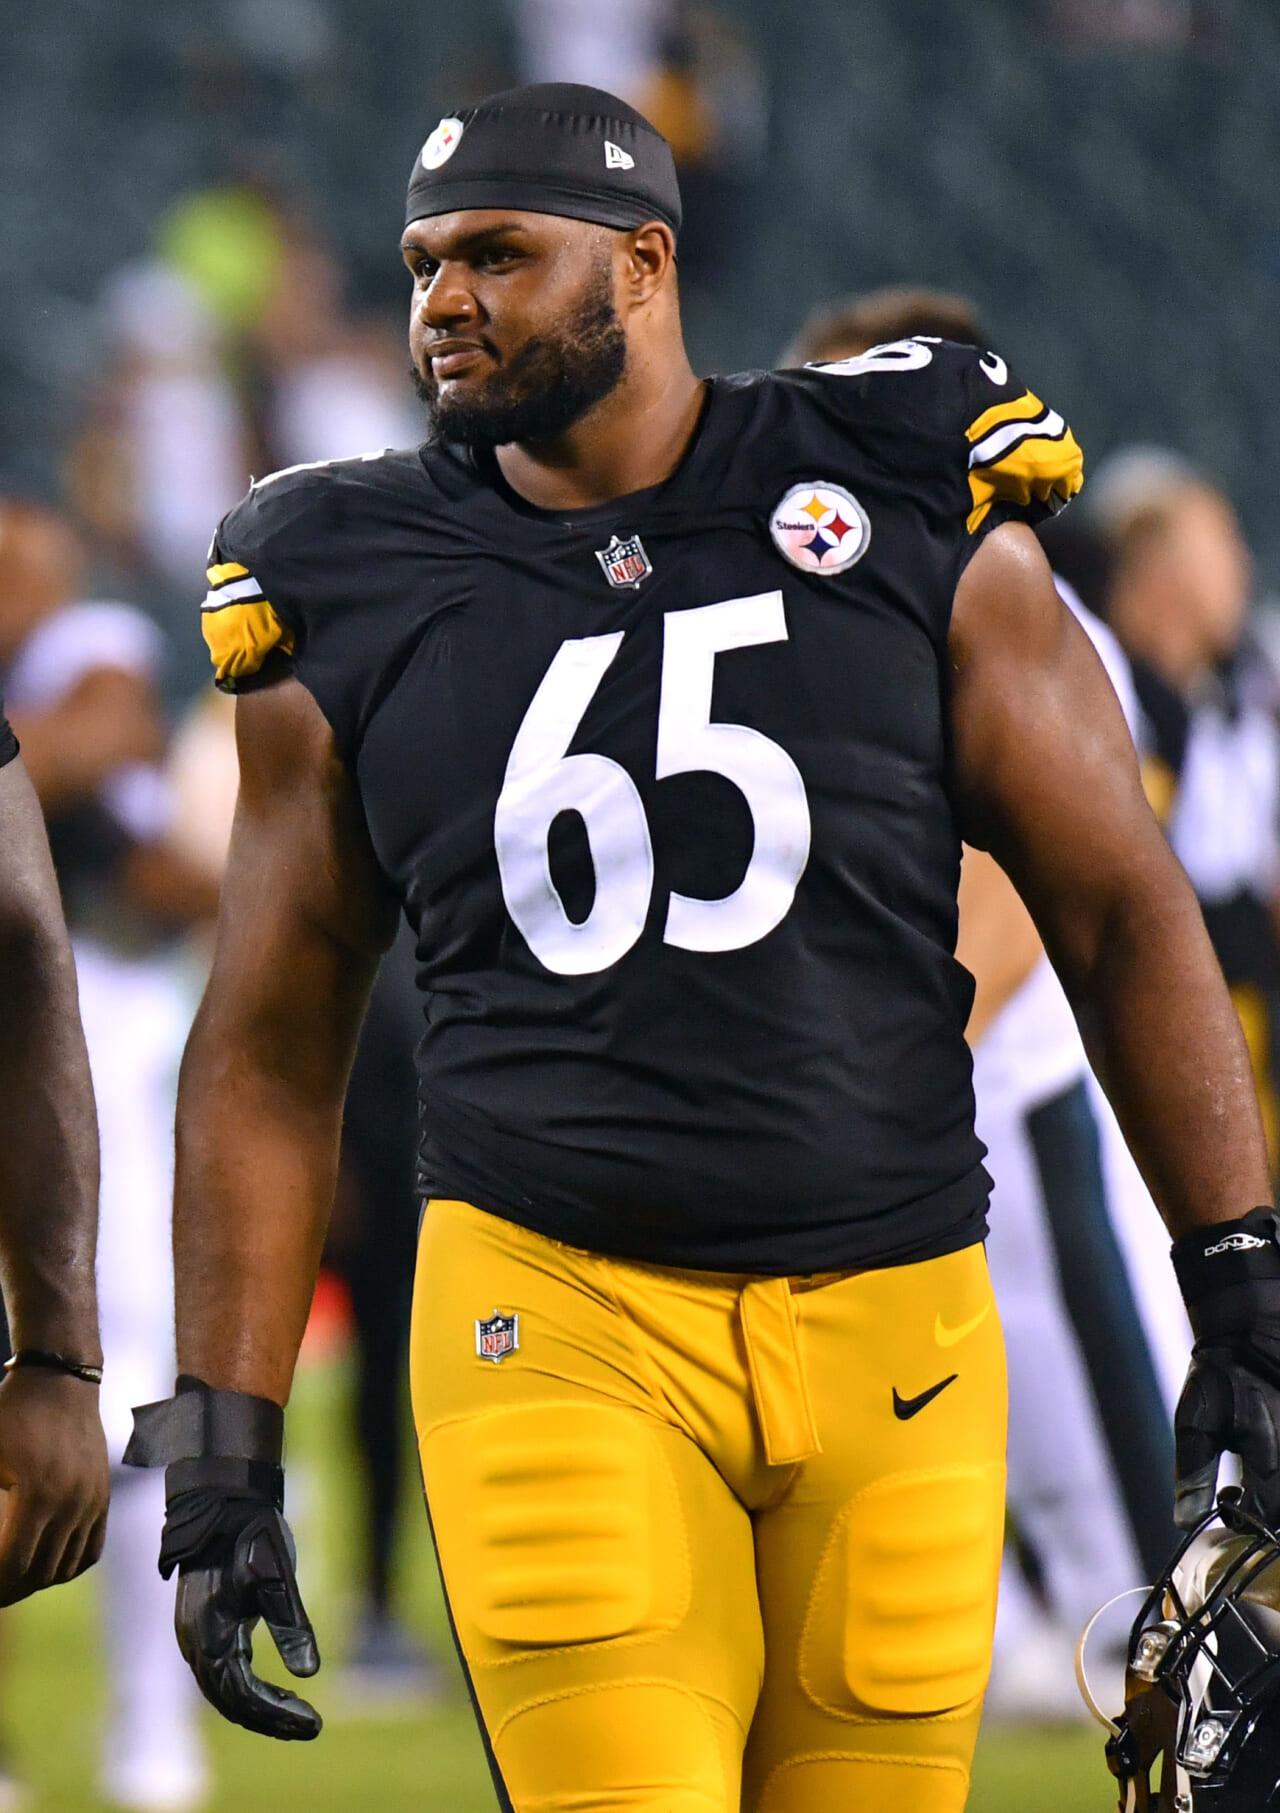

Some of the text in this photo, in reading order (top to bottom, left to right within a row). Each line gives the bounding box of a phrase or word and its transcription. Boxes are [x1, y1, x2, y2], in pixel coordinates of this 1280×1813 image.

[776, 520, 816, 531] Steelers
[611, 557, 644, 582] NFL
[494, 589, 811, 976] 65
[483, 1332, 511, 1354] NFL
